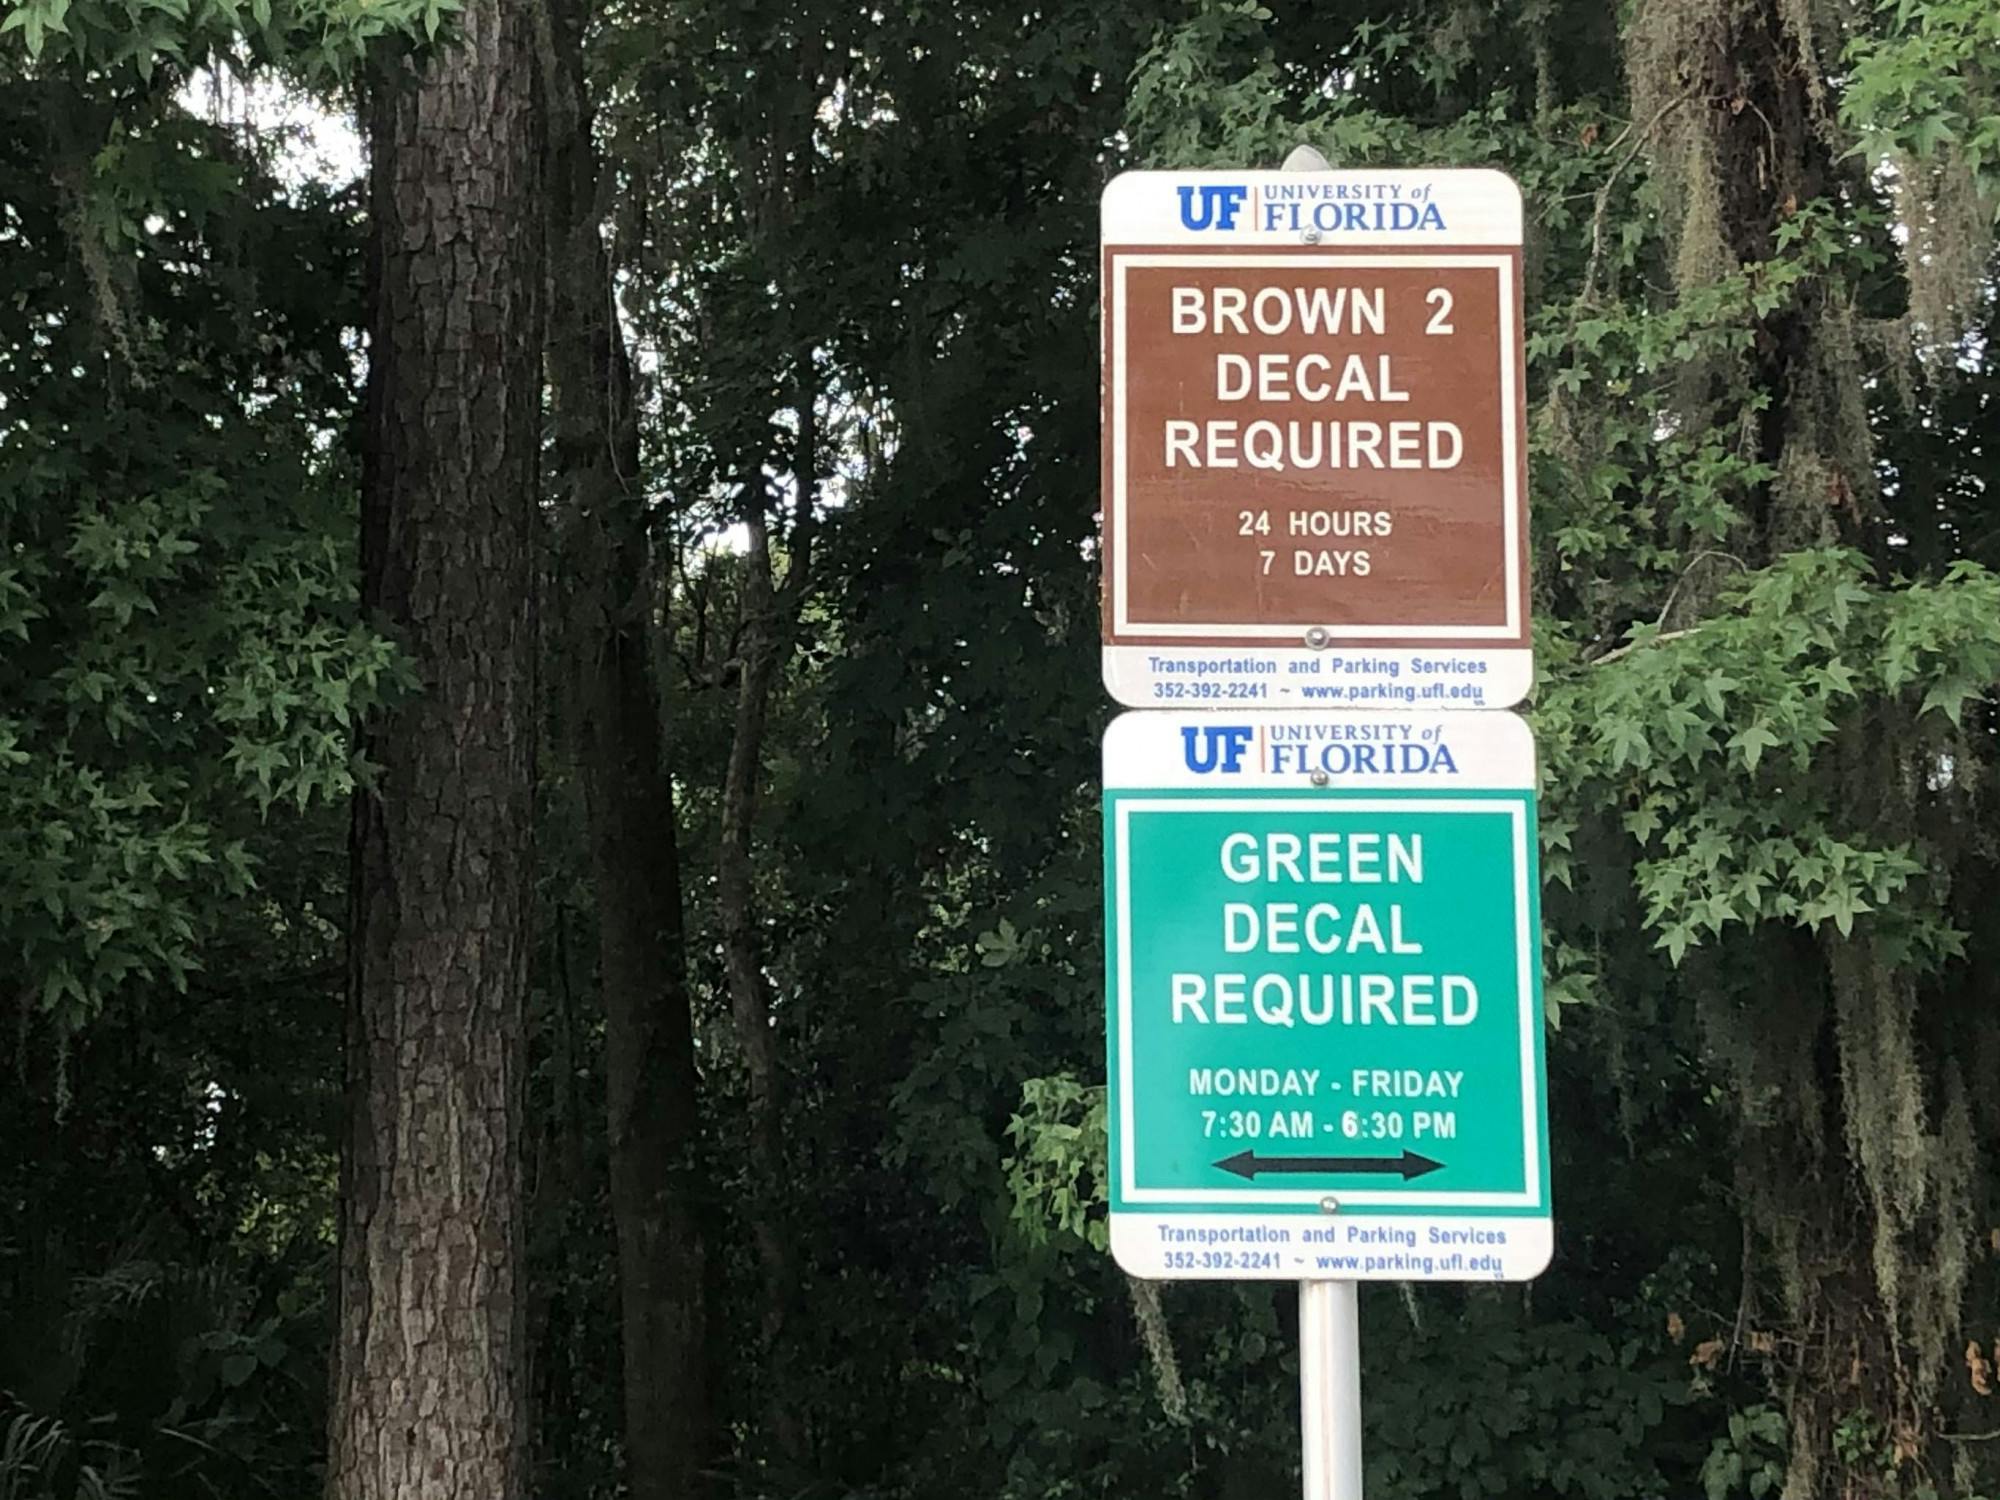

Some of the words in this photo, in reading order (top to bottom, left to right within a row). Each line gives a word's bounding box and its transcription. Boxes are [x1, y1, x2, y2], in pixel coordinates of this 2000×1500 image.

[1264, 184, 1402, 200] UNIVERSITY
[1412, 184, 1432, 201] of
[1177, 186, 1247, 230] UF
[1264, 203, 1447, 232] FLORIDA
[1172, 288, 1385, 334] BROWN
[1426, 288, 1454, 334] 2
[1217, 354, 1409, 402] DECAL
[1166, 420, 1463, 471] REQUIRED
[1238, 511, 1270, 536] 24
[1289, 512, 1392, 536] HOURS
[1260, 551, 1275, 575] 7
[1295, 551, 1371, 575] DAYS
[1149, 657, 1277, 676] Transportation
[1289, 658, 1320, 674] and
[1333, 658, 1399, 678] Parking
[1411, 658, 1487, 674] Services
[1154, 683, 1267, 698] 352-392-2241
[1302, 683, 1483, 701] www.parking.ufl.edu
[1270, 725, 1413, 741] UNIVERSITY
[1422, 725, 1443, 743] of
[1181, 727, 1252, 774] UF
[1271, 744, 1458, 775] FLORIDA
[1221, 833, 1423, 884] GREEN
[1224, 903, 1423, 954] DECAL
[1172, 973, 1478, 1027] REQUIRED
[1189, 1069, 1319, 1096] MONDAY
[1353, 1070, 1463, 1097] FRIDAY
[1202, 1111, 1261, 1137] 7:30
[1269, 1112, 1313, 1137] AM
[1342, 1112, 1402, 1138] 6:30
[1413, 1112, 1456, 1139] PM
[1158, 1225, 1290, 1244] Transportation
[1302, 1227, 1335, 1242] and
[1348, 1227, 1416, 1246] Parking
[1429, 1227, 1506, 1244] Services
[1164, 1252, 1280, 1268] 352-392-2241
[1316, 1254, 1502, 1272] www.parking.ufl.edu
